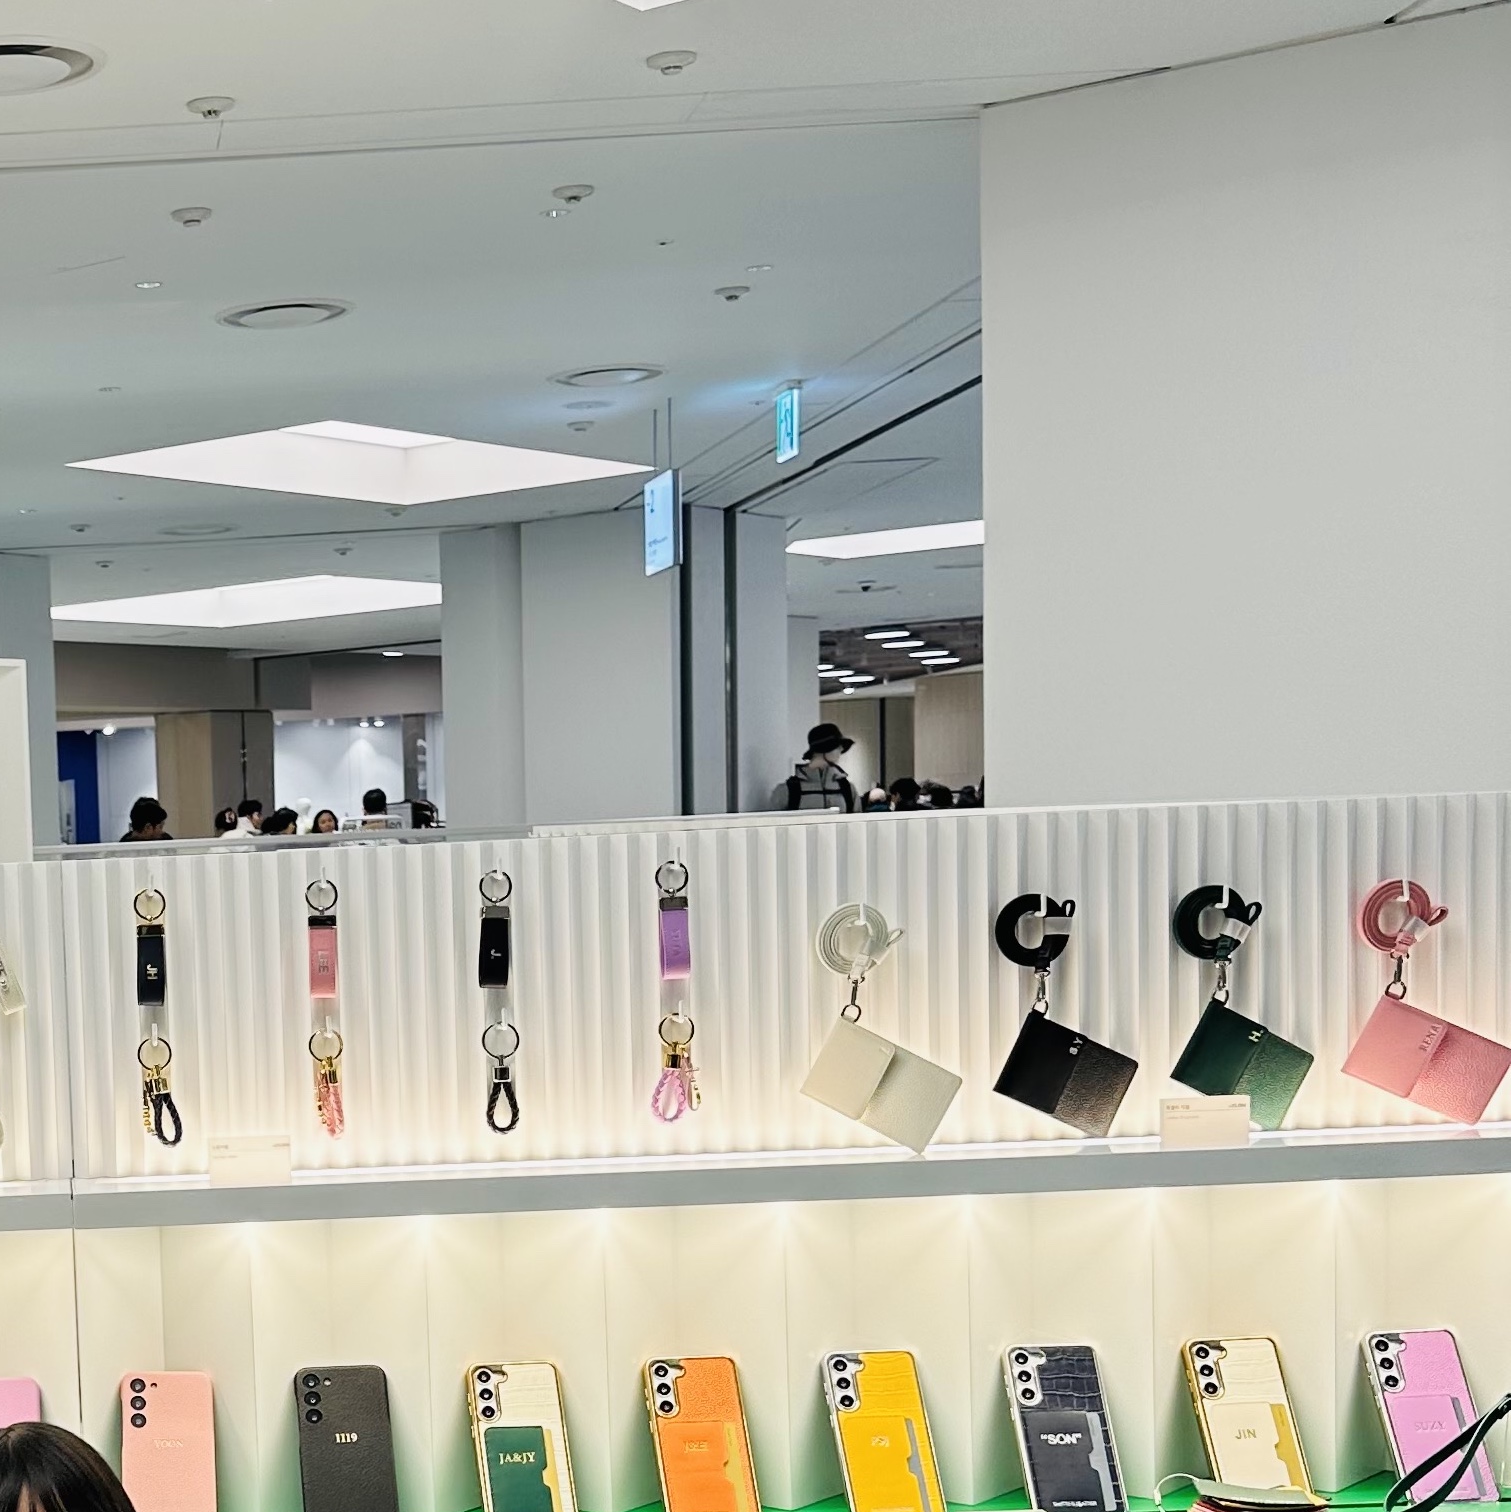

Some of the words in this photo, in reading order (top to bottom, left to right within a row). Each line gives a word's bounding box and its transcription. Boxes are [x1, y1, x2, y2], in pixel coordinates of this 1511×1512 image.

[146, 963, 158, 980] JH
[335, 1432, 358, 1443] 1119
[1234, 1428, 1257, 1440] JIN
[498, 1451, 536, 1465] JA&JY
